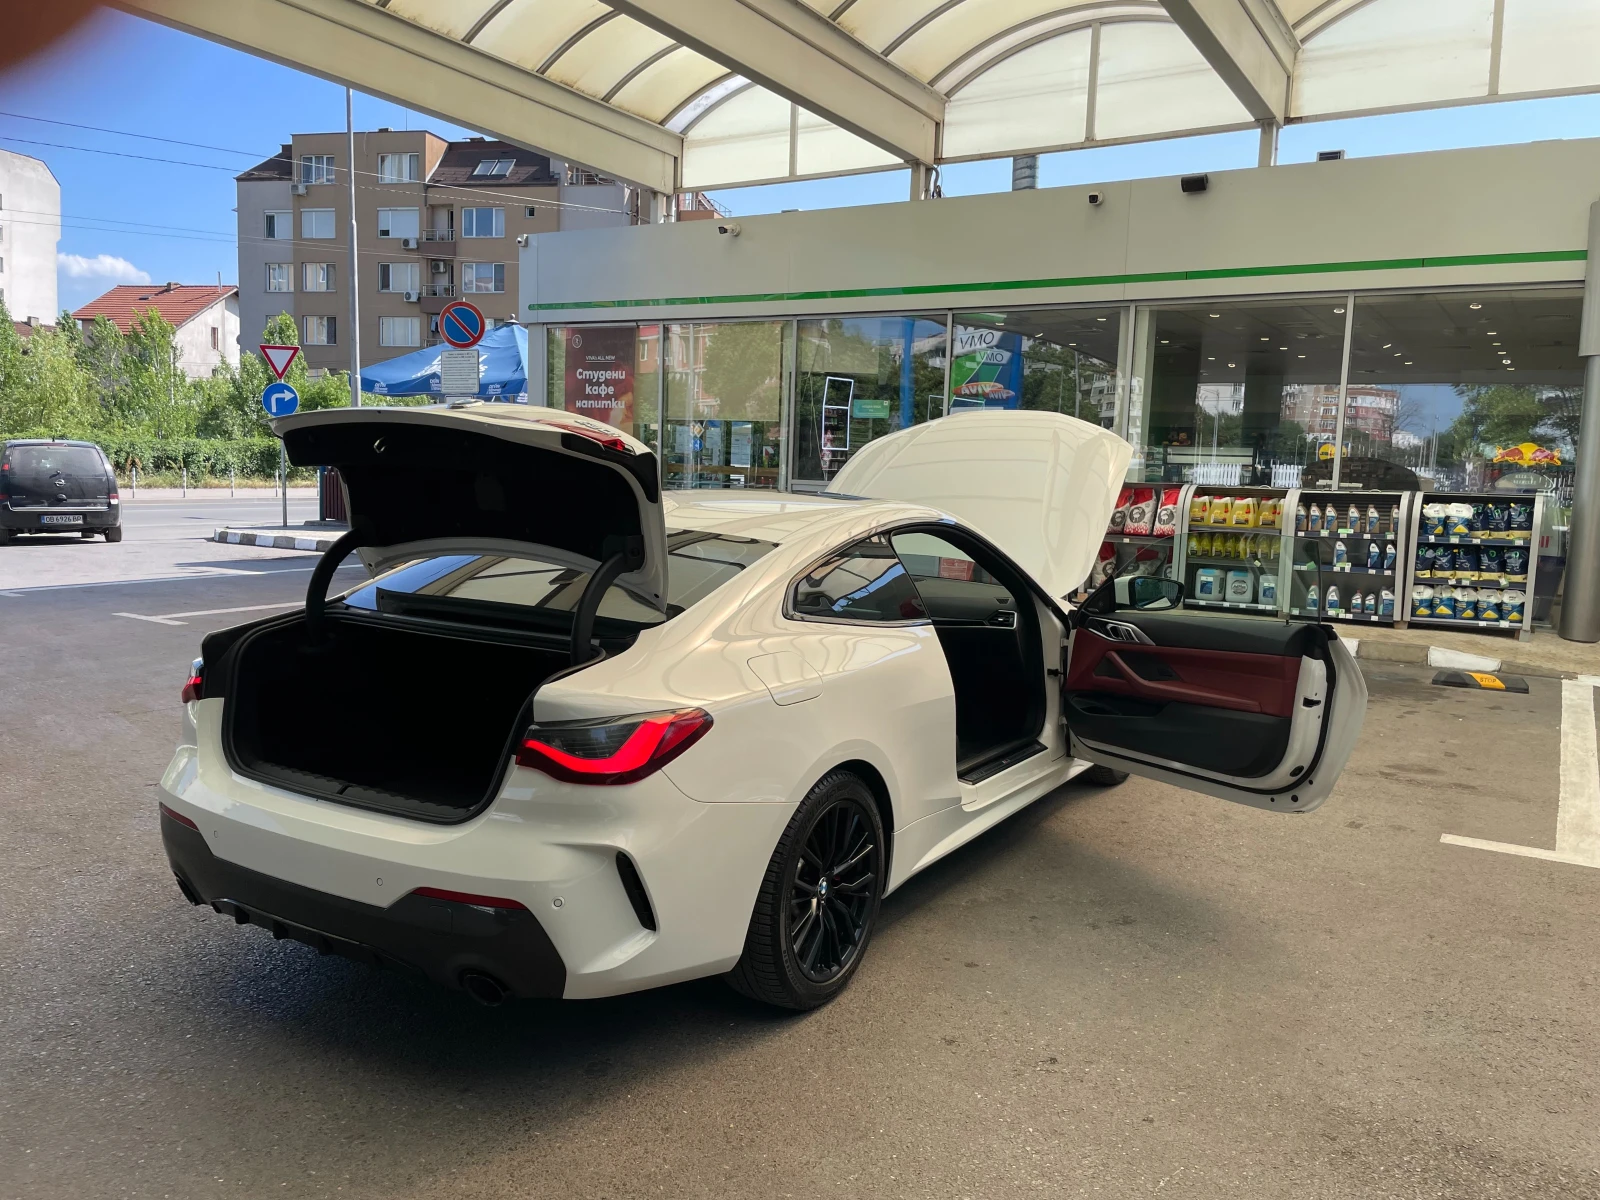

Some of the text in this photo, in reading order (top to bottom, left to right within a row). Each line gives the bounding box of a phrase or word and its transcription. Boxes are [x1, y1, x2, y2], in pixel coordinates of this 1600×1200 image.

[576, 368, 626, 382] Студени
[585, 383, 615, 397] кафе
[575, 398, 625, 409] напитки
